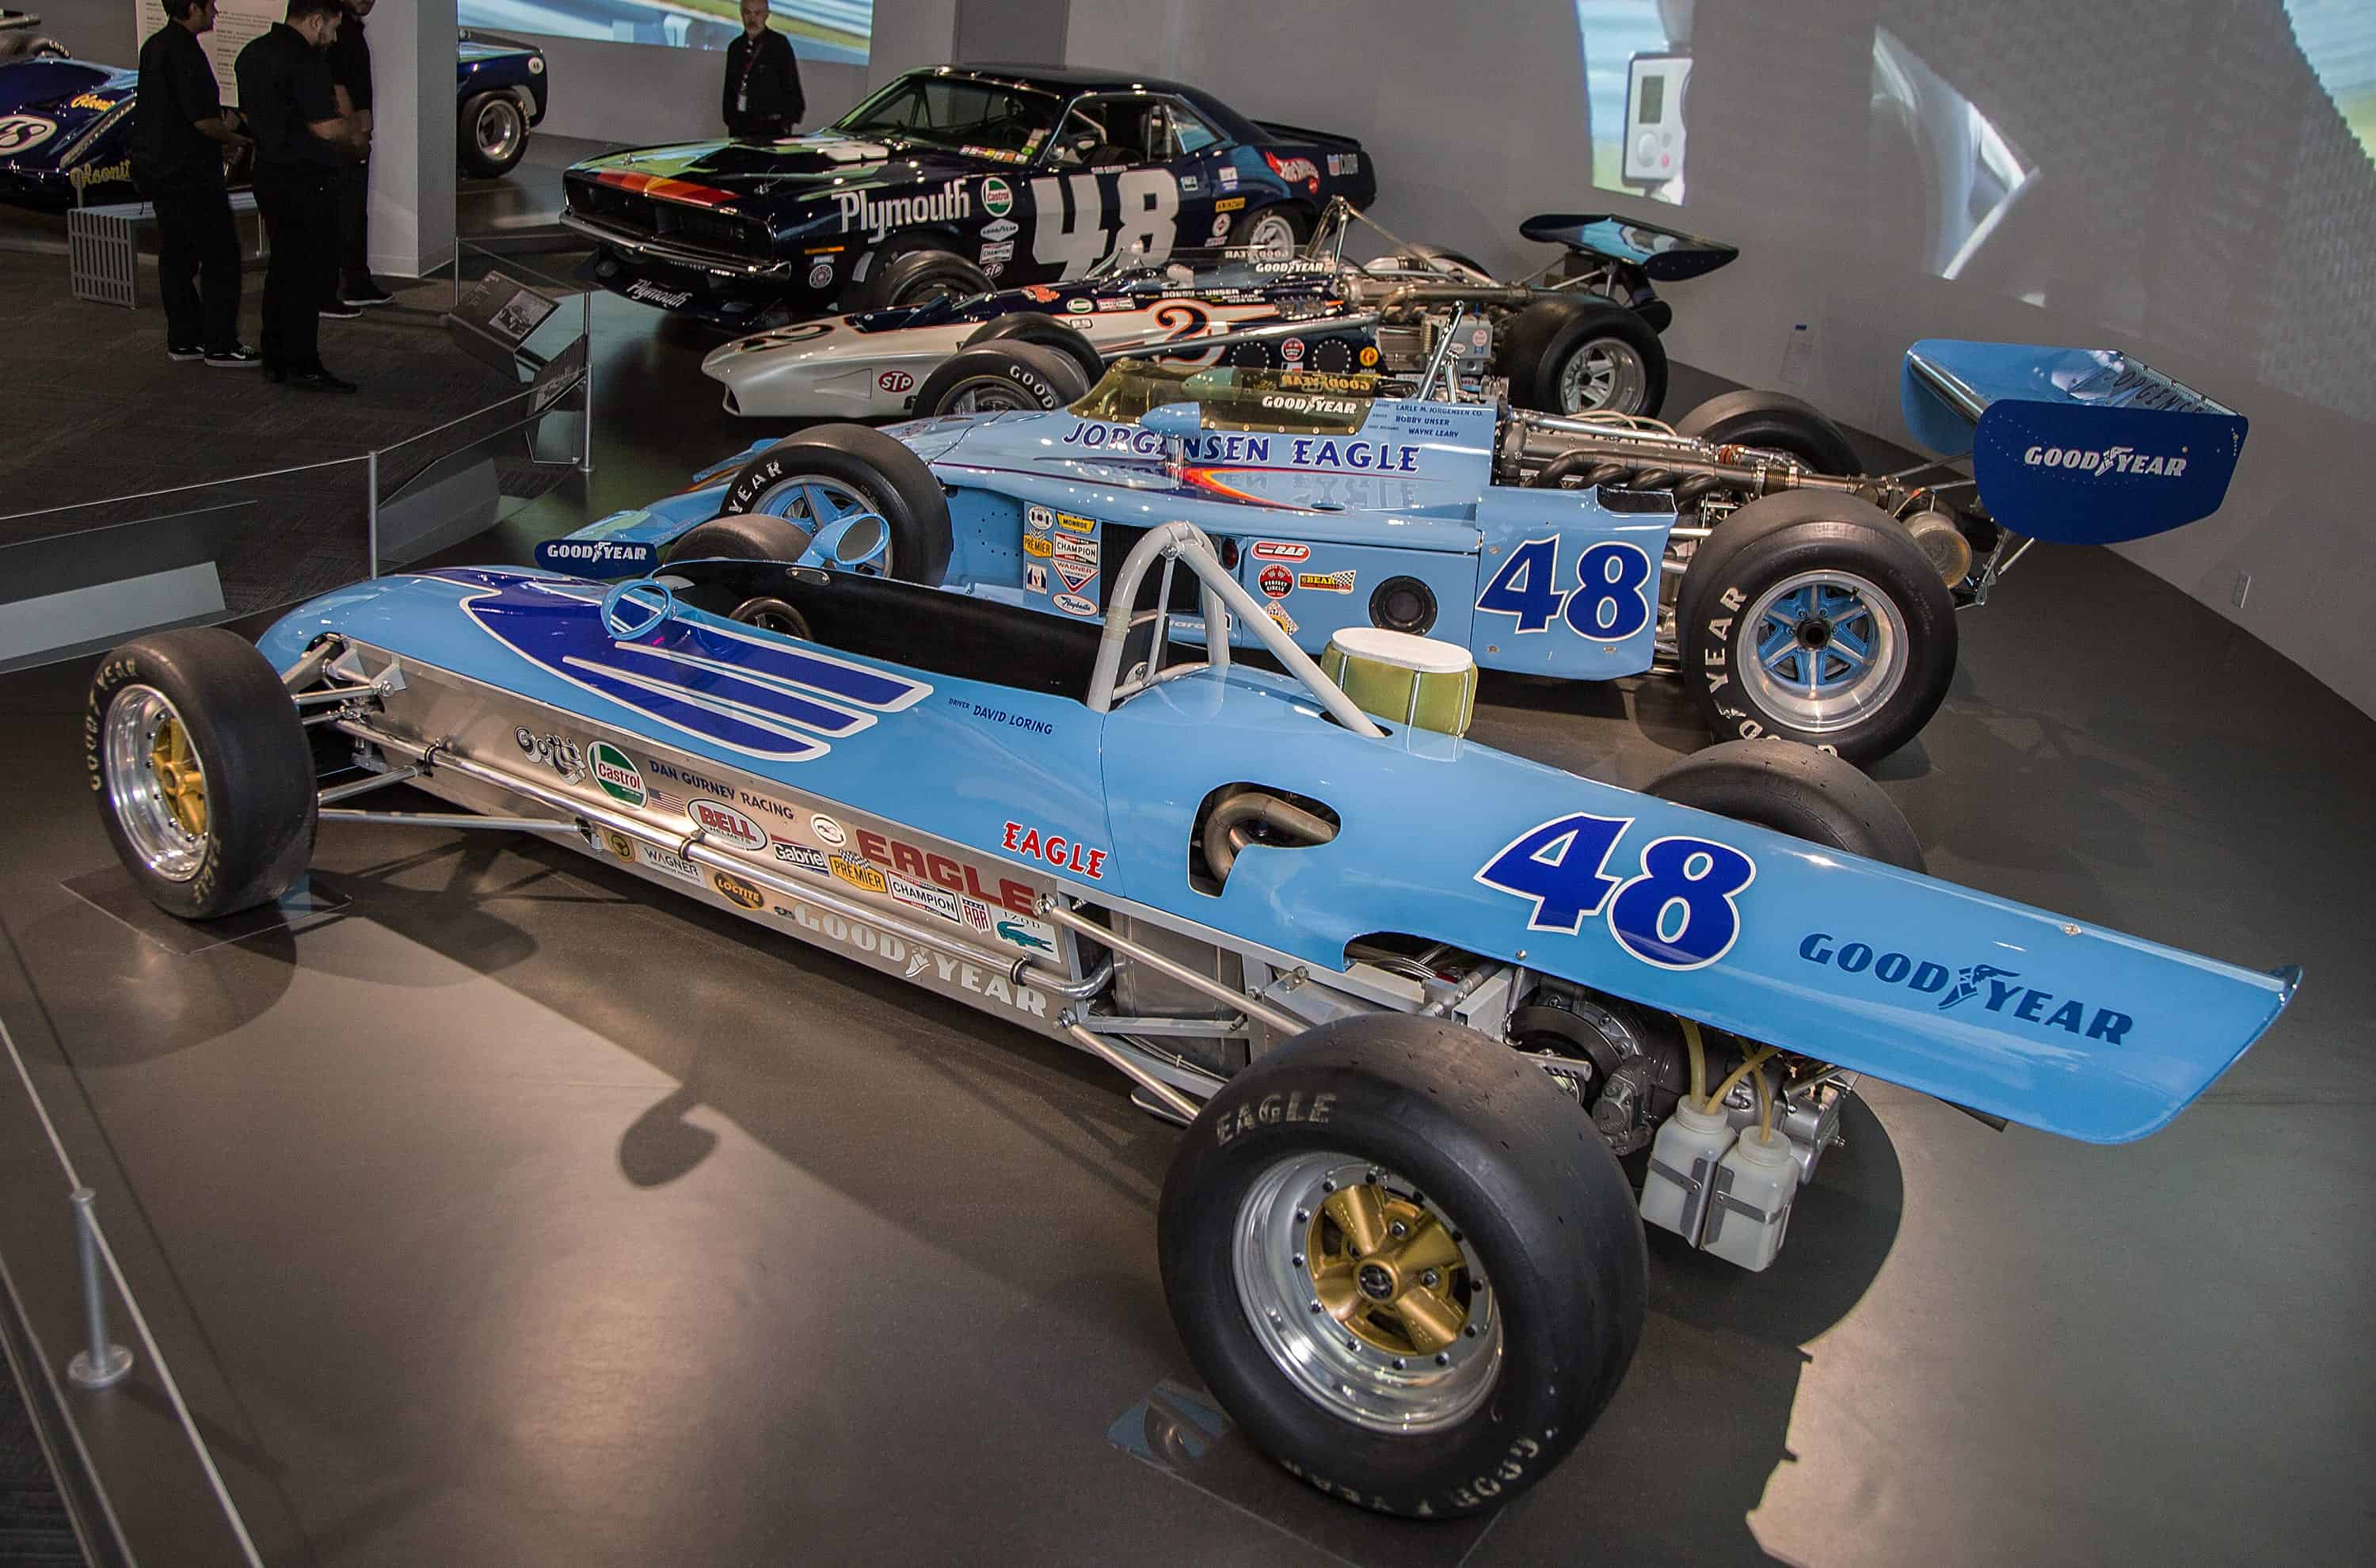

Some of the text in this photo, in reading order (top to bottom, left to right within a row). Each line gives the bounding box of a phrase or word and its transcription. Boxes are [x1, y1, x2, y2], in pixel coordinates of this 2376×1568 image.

[987, 190, 1010, 201] Castrol
[830, 178, 972, 244] Plymouth
[1030, 168, 1178, 281] 48
[984, 263, 1003, 277] STP
[626, 279, 693, 308] Plymouth
[881, 371, 912, 392] STP
[1009, 365, 1057, 409] GOOD
[1396, 415, 1422, 424] BOBBY
[1424, 417, 1450, 426] UNSER
[1429, 407, 1470, 416] JORGENSEN
[1292, 438, 1421, 474] EAGLE
[728, 459, 783, 514] YEAR
[1063, 518, 1088, 530] MONROE
[1024, 537, 1051, 555] PREMIER
[1057, 541, 1096, 558] CHAMPION
[1057, 561, 1092, 574] WAGNER
[1475, 534, 1651, 642] 48
[1705, 584, 1749, 695] YEAR
[973, 705, 1007, 722] DAVID
[1009, 715, 1053, 735] LORING
[598, 762, 642, 790] Castrol
[649, 759, 794, 820] DAN GURNEY RACING
[698, 804, 757, 843] BELL
[644, 847, 699, 876] WAGNER
[773, 843, 826, 867] Gabriel
[1002, 820, 1108, 880] EAGLE
[834, 859, 883, 889] PREMIER
[855, 828, 1040, 920] EAGLE
[718, 878, 760, 901] LOCTITE
[893, 881, 956, 915] CHAMPION
[1474, 812, 1757, 971] 48
[1216, 1090, 1338, 1145] EAGLE
